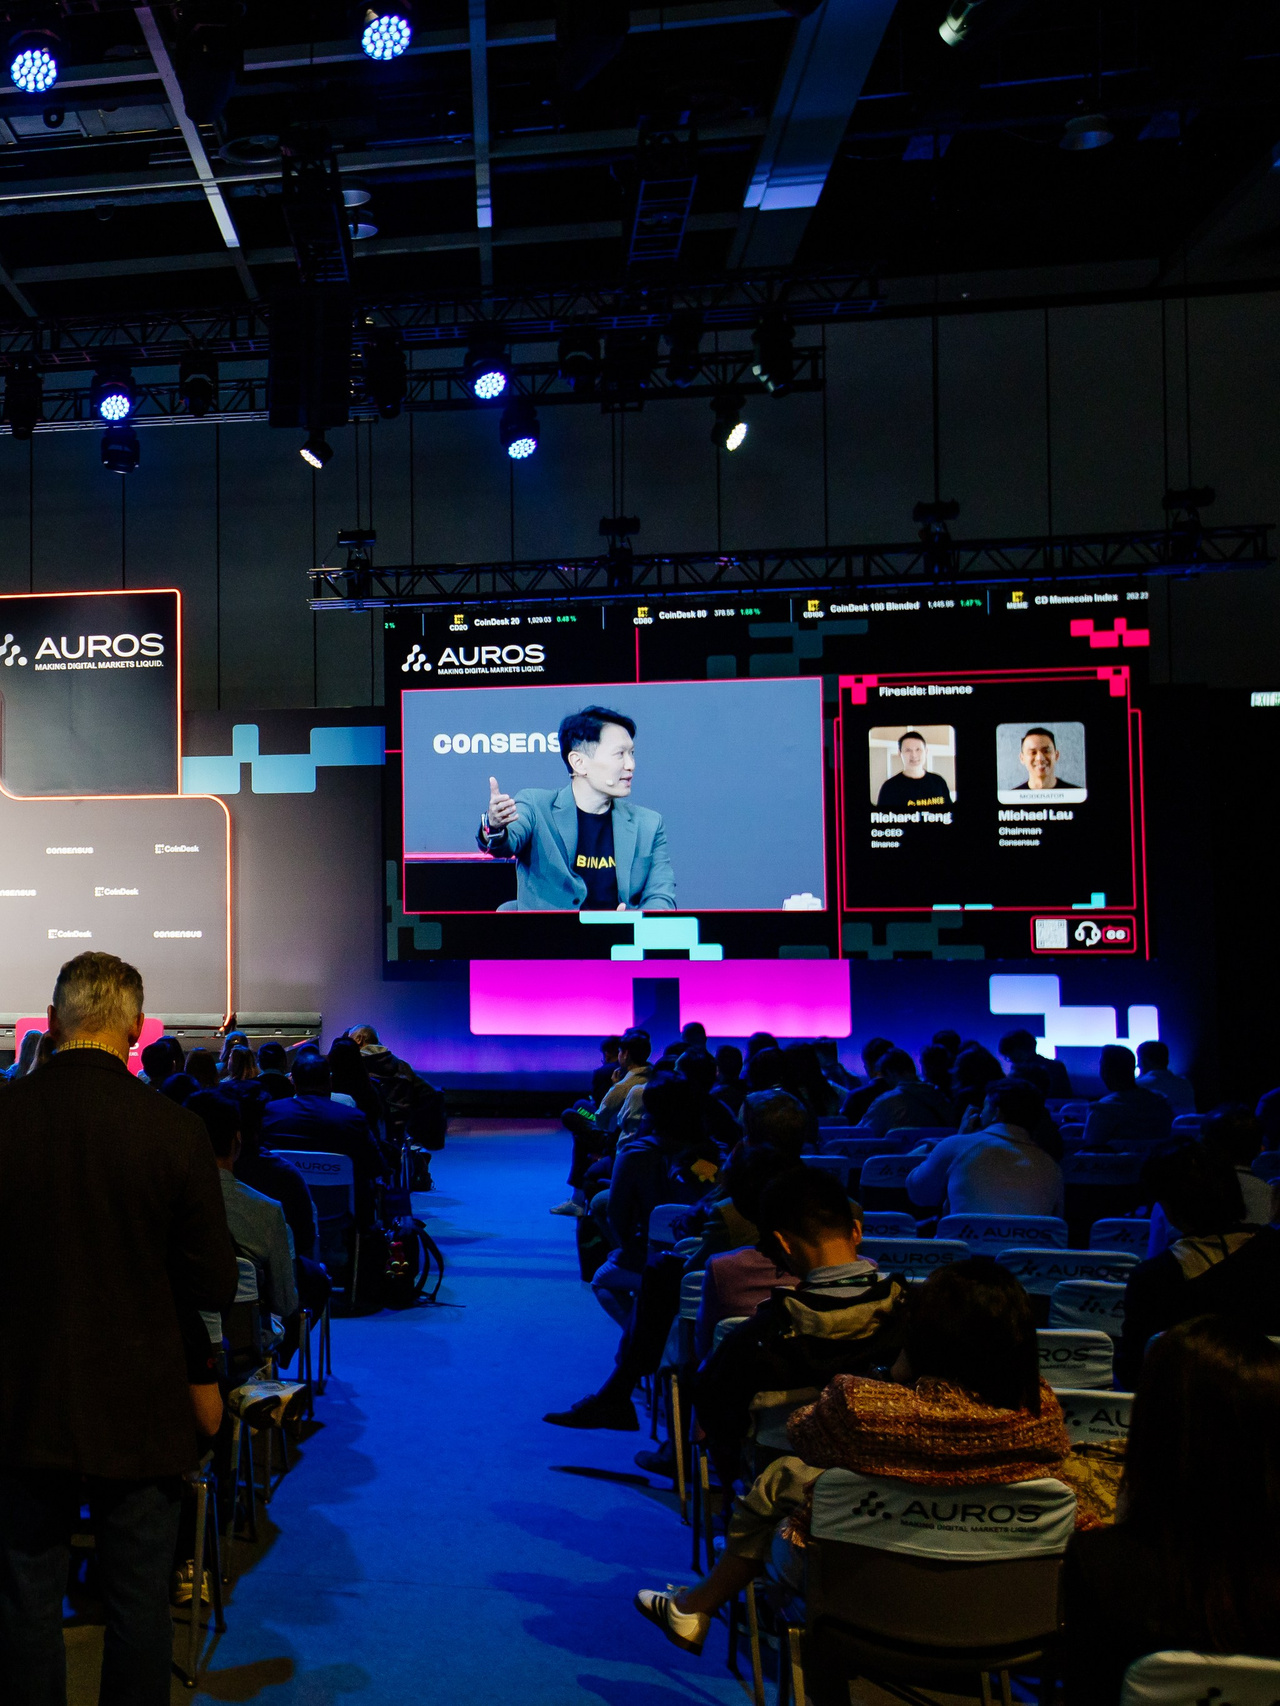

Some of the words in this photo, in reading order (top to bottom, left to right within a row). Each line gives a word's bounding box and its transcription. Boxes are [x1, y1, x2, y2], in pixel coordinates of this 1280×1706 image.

[1035, 595, 1048, 605] CD
[1050, 594, 1093, 604] Memecoin
[1094, 593, 1118, 602] Index
[830, 604, 869, 613] CoinDesk
[870, 602, 885, 612] 100
[886, 601, 920, 611] Blended
[659, 610, 696, 619] CoinDesk
[474, 618, 509, 626] CoinDesk
[510, 617, 520, 625] 20
[35, 633, 164, 660] AUROS
[438, 644, 545, 666] AUROS
[35, 662, 66, 671] MAKING
[67, 662, 97, 670] DIGITAL
[98, 661, 135, 669] MARKETS
[135, 660, 164, 668] LIQUID.
[879, 686, 927, 697] Fireside:
[928, 685, 973, 696] Binance
[433, 732, 560, 755] CONSENS
[870, 812, 919, 824] Richard
[921, 811, 952, 825] Teng
[998, 809, 1048, 821] Michael
[1049, 809, 1073, 821] Lau
[871, 828, 903, 838] Co-CEO
[998, 826, 1042, 836] Chairman
[164, 844, 199, 853] CoinDesk
[871, 840, 899, 849] Binance
[999, 838, 1040, 847] Consensus
[46, 847, 94, 855] CONSENSUS
[576, 854, 616, 870] BINAN
[104, 887, 139, 896] CoinDesk
[57, 929, 92, 939] CoinDesk
[153, 930, 203, 939] CONSENSUS
[983, 1227, 1052, 1241] AUROS
[878, 1252, 954, 1265] AUROS
[1038, 1348, 1089, 1362] ROS
[901, 1500, 1043, 1524] AUROS
[900, 1519, 935, 1531] MAKING
[937, 1524, 969, 1533] DIGITAL
[971, 1526, 1010, 1534] MARKETS
